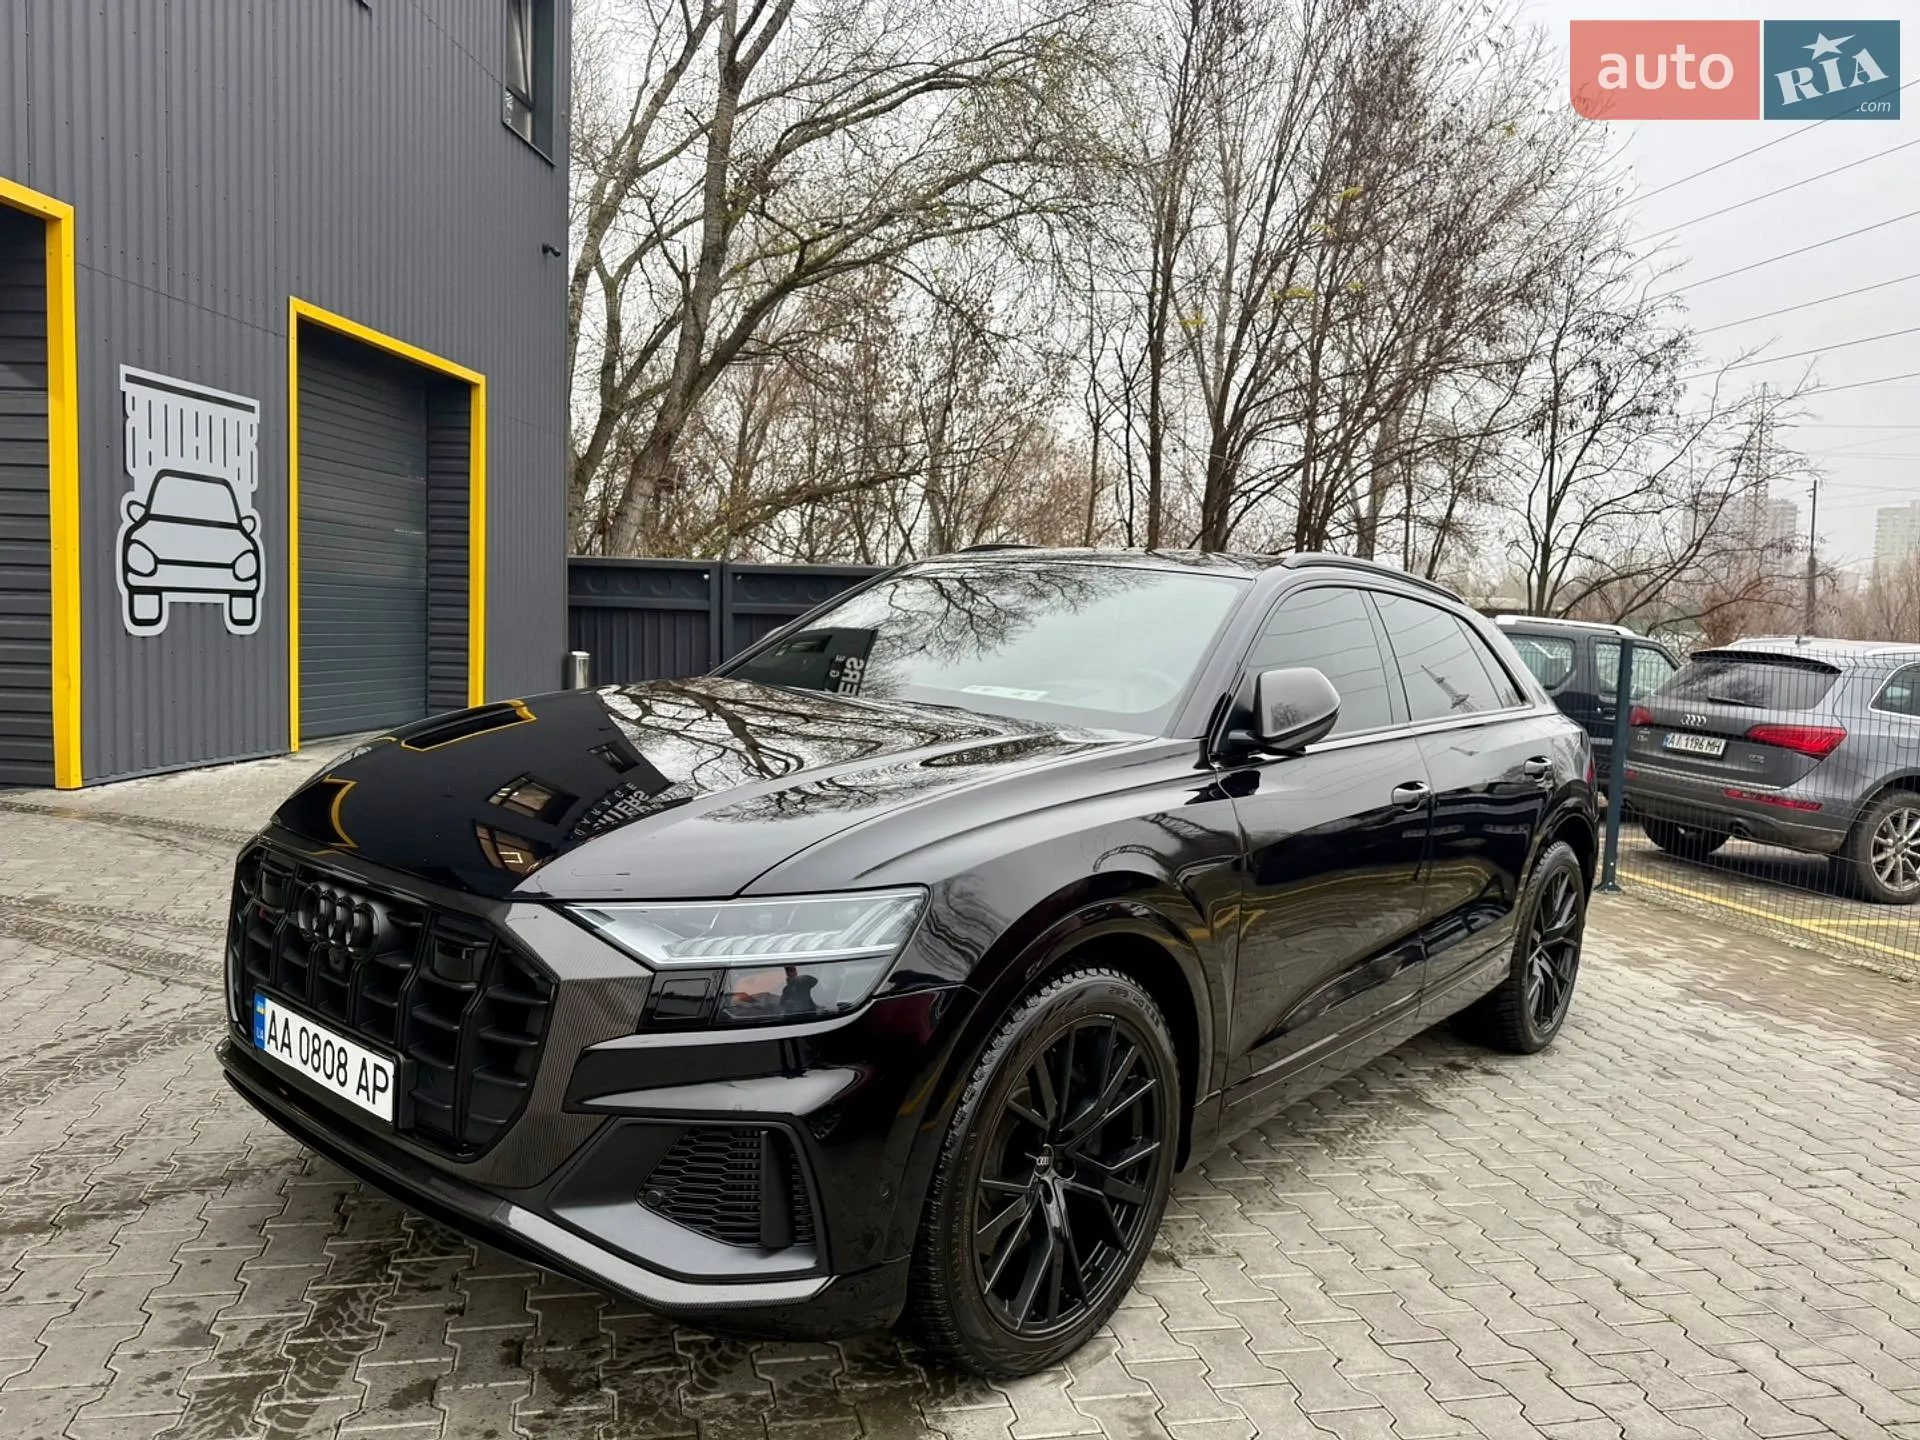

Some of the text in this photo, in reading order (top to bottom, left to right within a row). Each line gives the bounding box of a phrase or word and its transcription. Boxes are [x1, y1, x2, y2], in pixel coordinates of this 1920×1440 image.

[267, 1009, 390, 1106] AA 0808 AP
